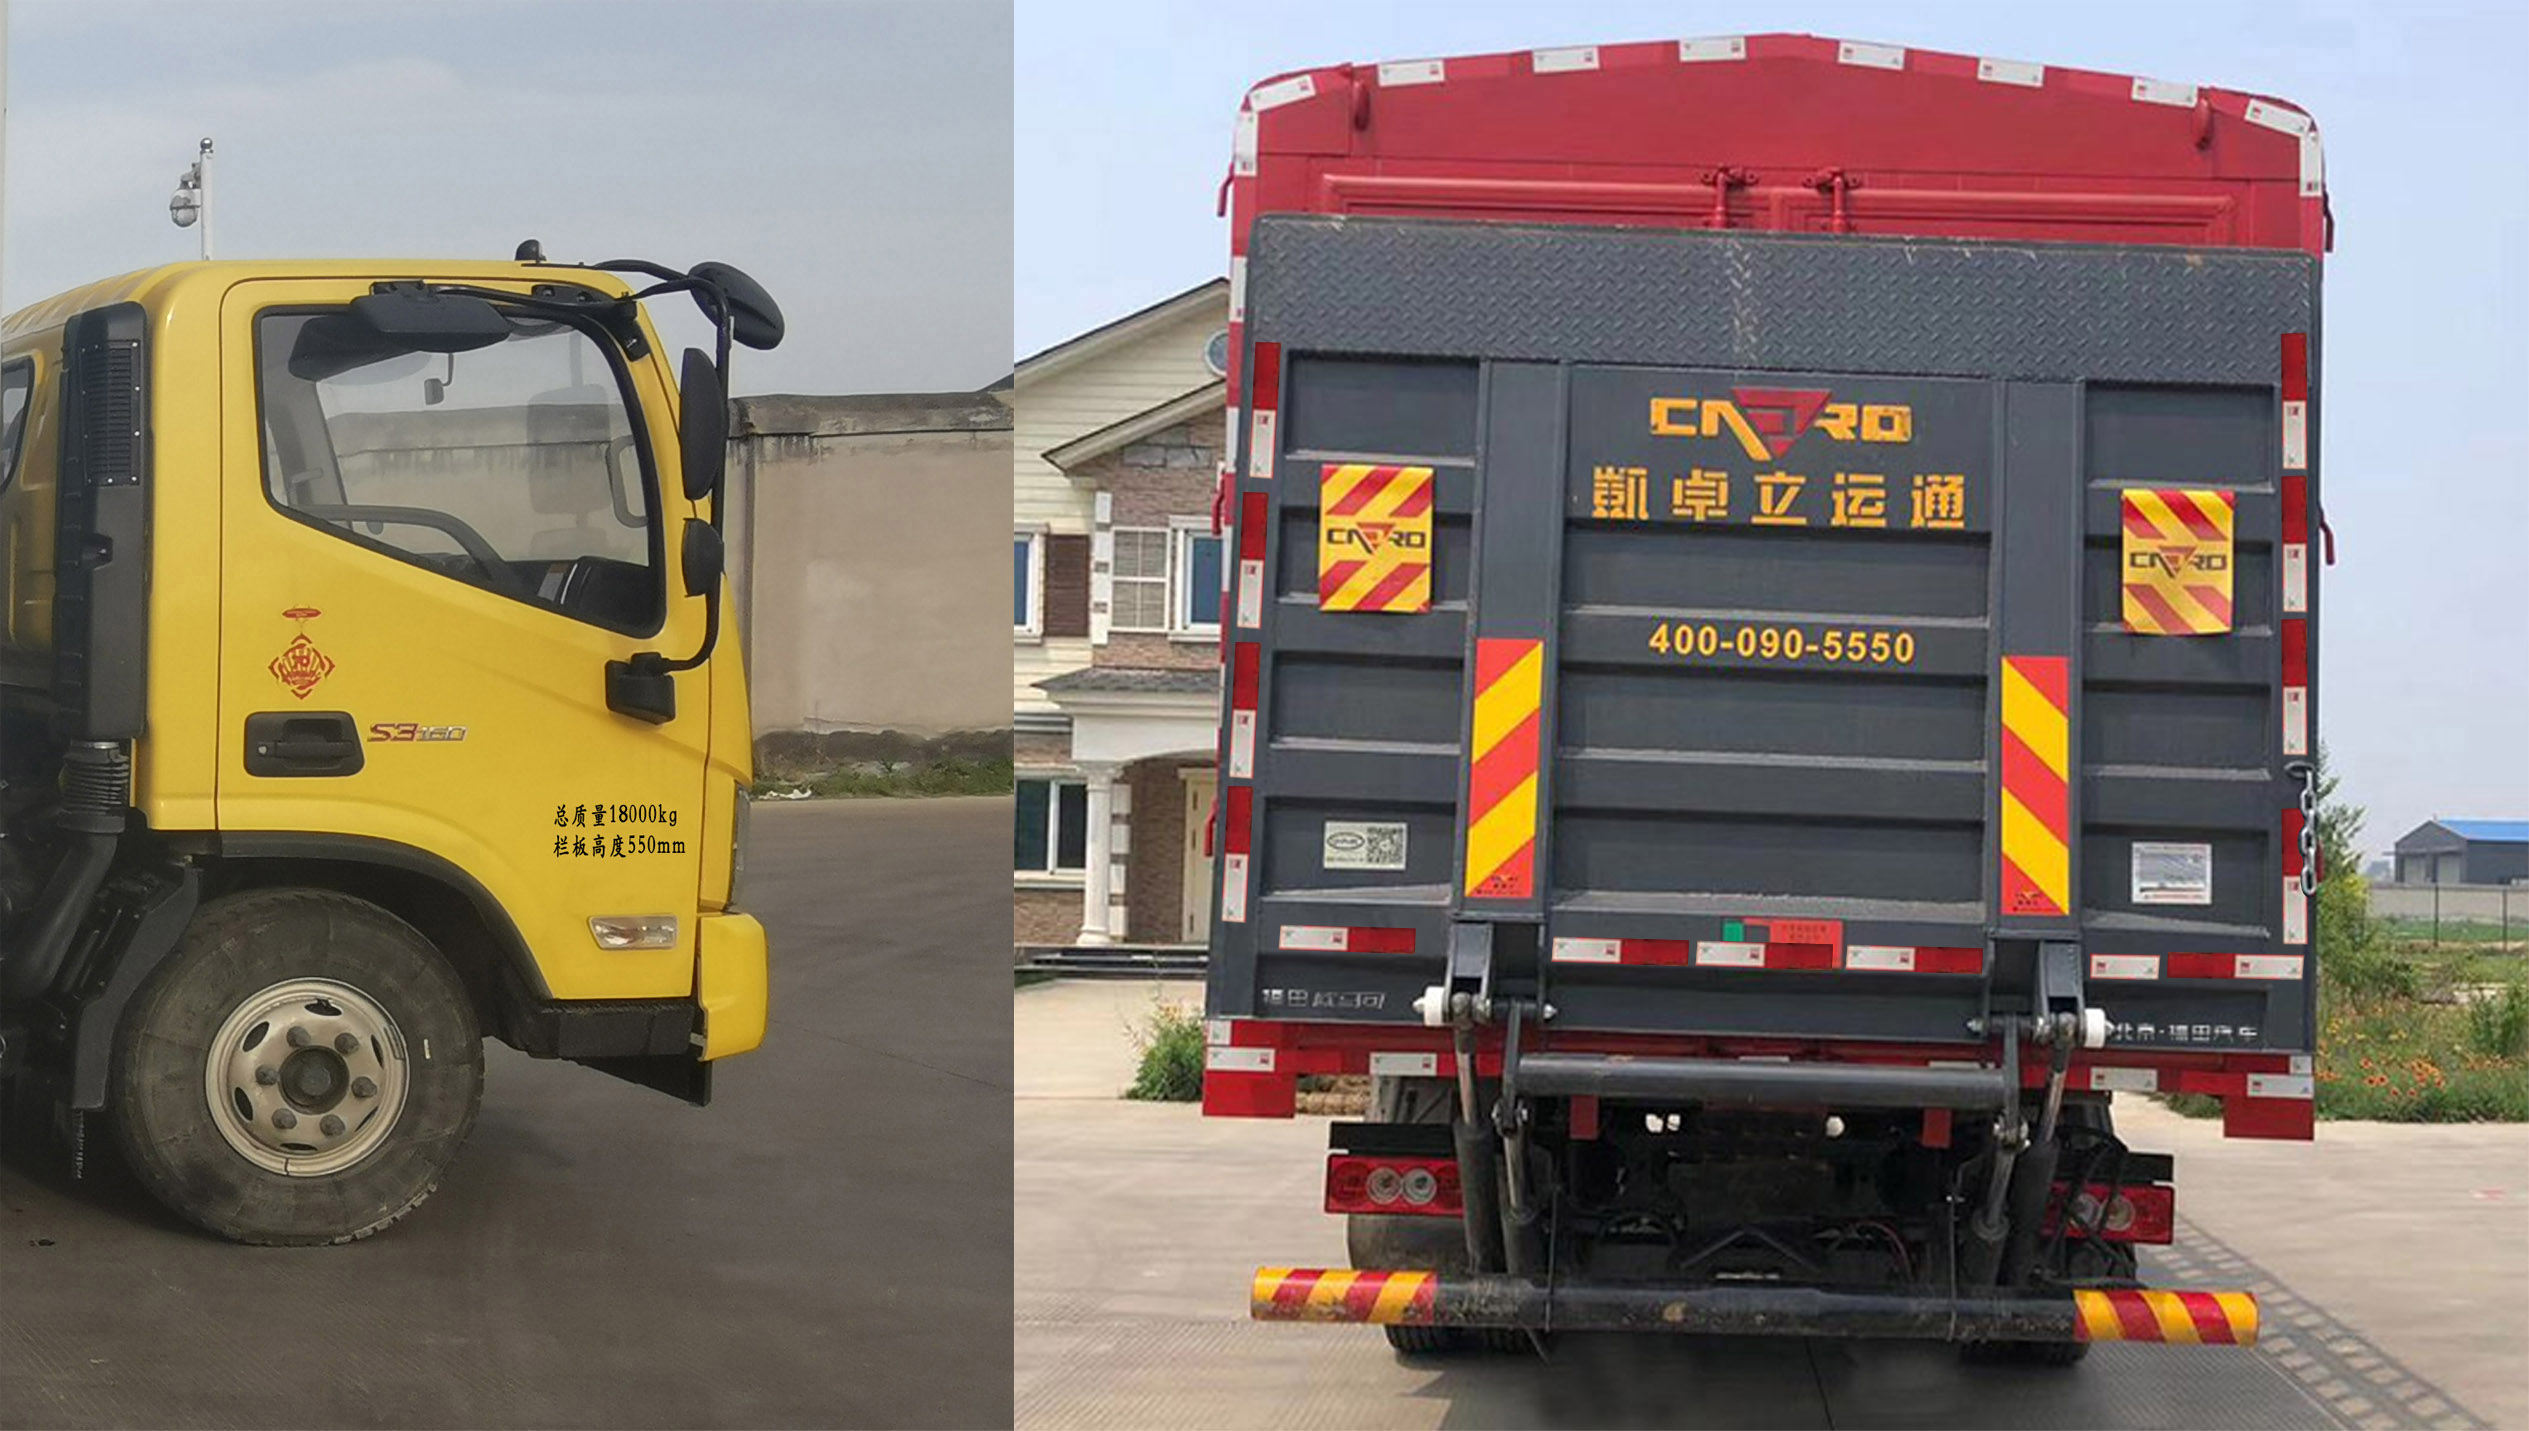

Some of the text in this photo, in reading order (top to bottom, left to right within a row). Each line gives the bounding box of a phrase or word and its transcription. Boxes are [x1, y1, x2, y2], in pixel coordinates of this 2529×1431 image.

[1649, 623, 1915, 663] 400-090-5550
[554, 803, 678, 828] 总质量18000kg
[553, 834, 686, 858] 栏板高度550mm
